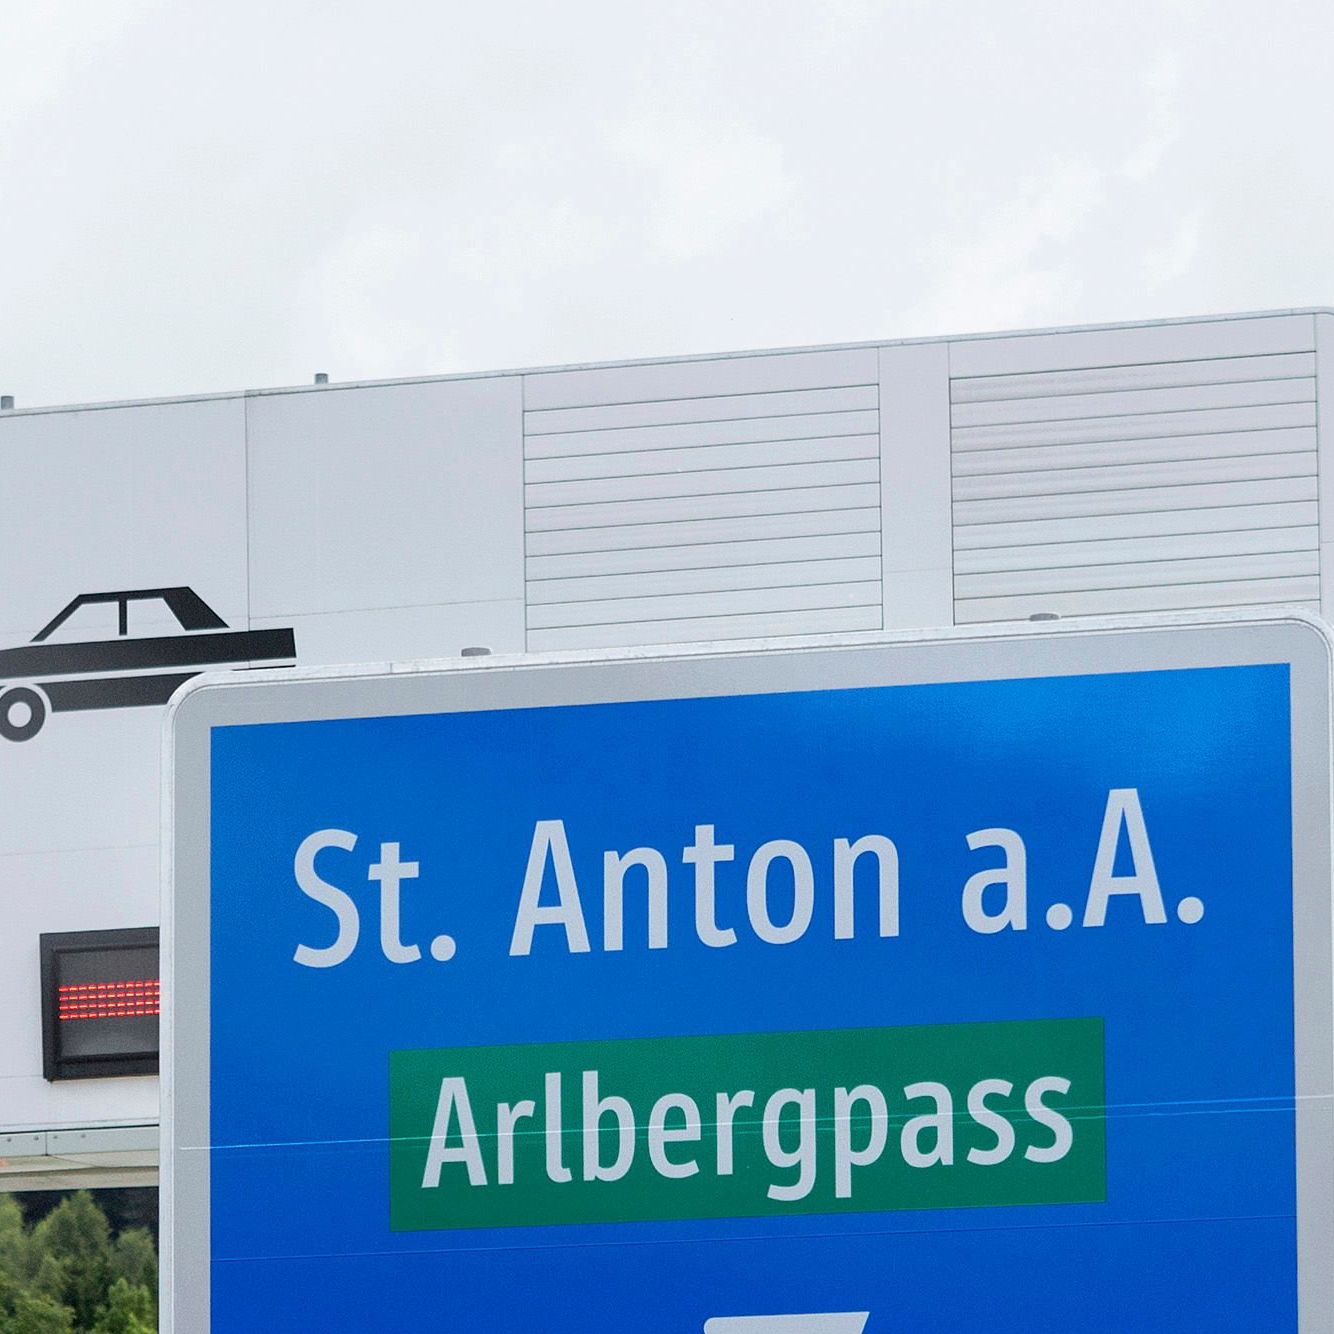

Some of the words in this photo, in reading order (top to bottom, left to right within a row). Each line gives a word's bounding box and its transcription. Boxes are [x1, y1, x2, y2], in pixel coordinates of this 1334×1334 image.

[294, 829, 456, 967] St.
[509, 820, 899, 956] Anton
[962, 788, 1205, 933] a.A.
[422, 1070, 1074, 1202] Arlbergpass
